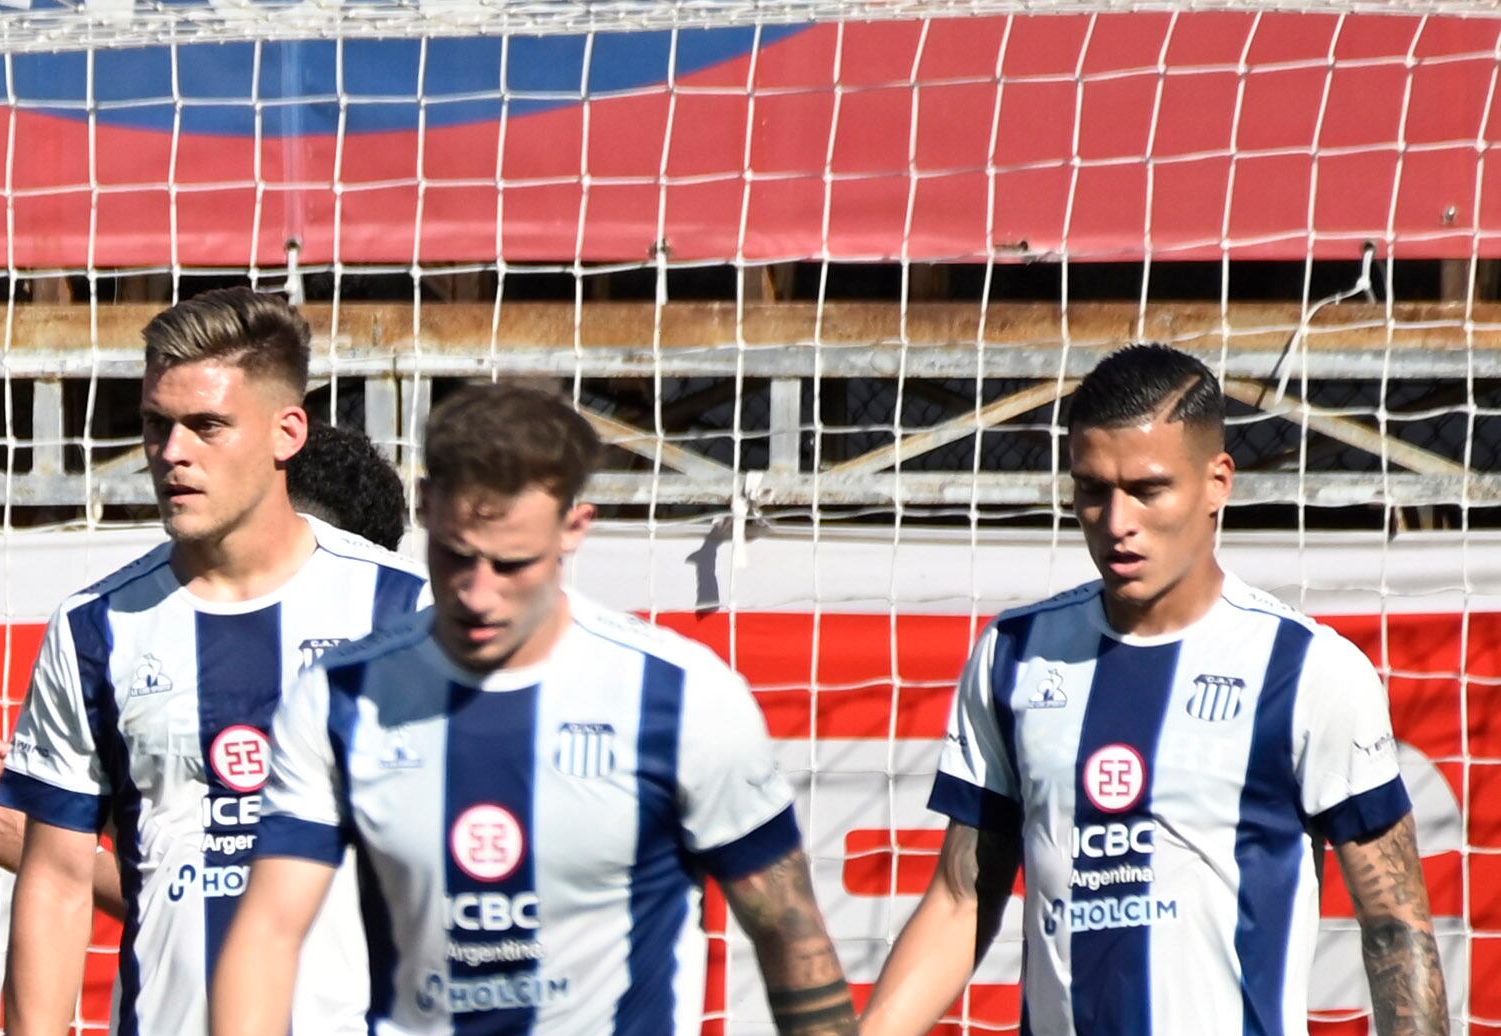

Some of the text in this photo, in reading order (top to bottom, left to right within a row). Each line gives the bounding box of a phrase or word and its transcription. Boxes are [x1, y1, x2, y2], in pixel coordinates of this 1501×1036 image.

[1071, 820, 1155, 858] ICBC
[1068, 864, 1154, 890] Argentina
[445, 891, 541, 932] ICBC
[1070, 900, 1178, 928] HOLCIM
[446, 940, 547, 967] Argentina
[449, 976, 570, 1009] HOLCIM
